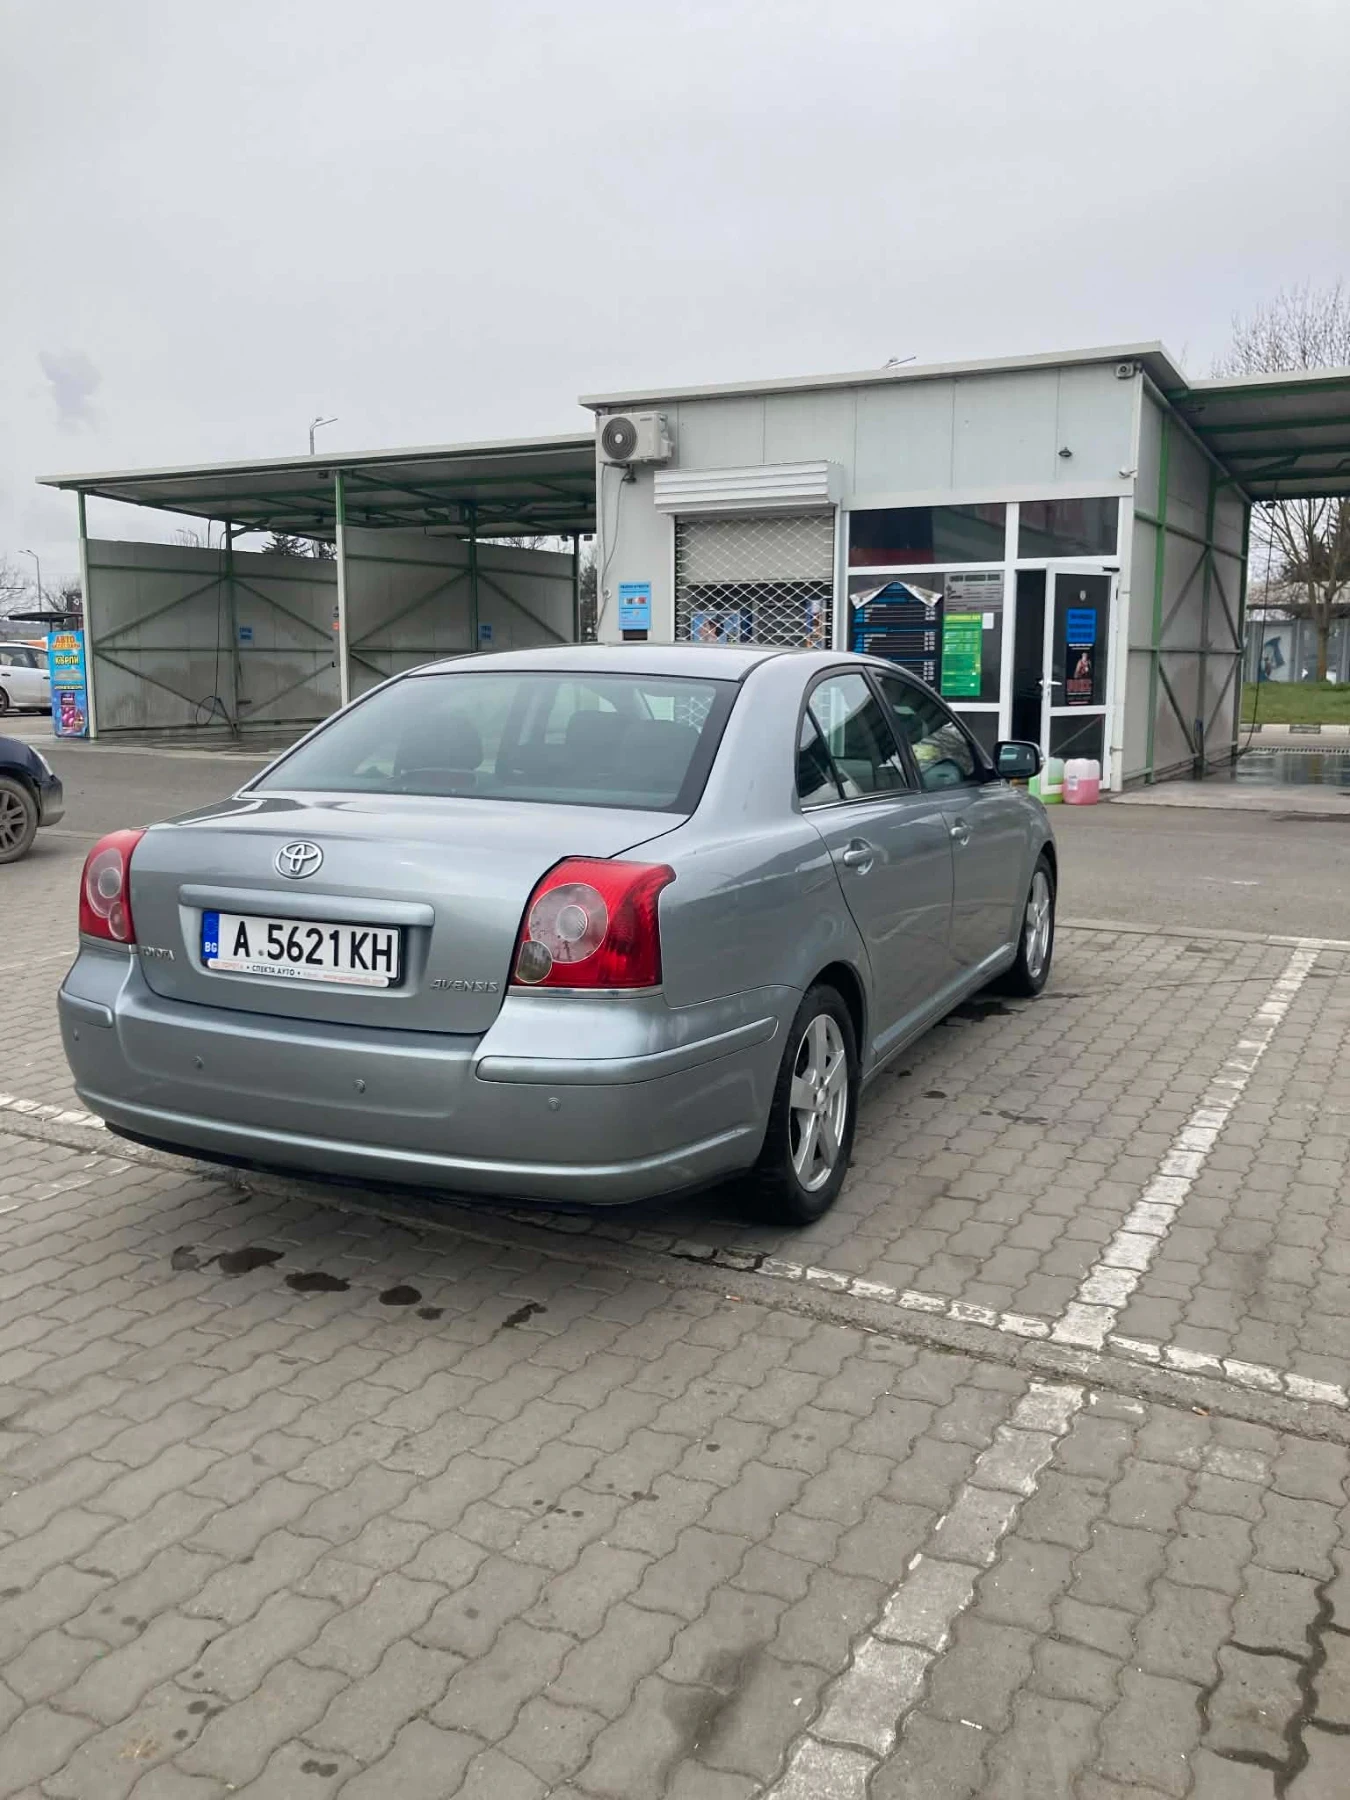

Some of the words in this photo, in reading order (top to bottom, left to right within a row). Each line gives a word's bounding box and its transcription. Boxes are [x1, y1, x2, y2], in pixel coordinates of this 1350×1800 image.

[56, 635, 75, 643] АВТО
[55, 655, 79, 665] КЪРПИ
[204, 941, 218, 953] BG
[267, 923, 340, 967] 5621
[430, 979, 500, 994] AVENSIS
